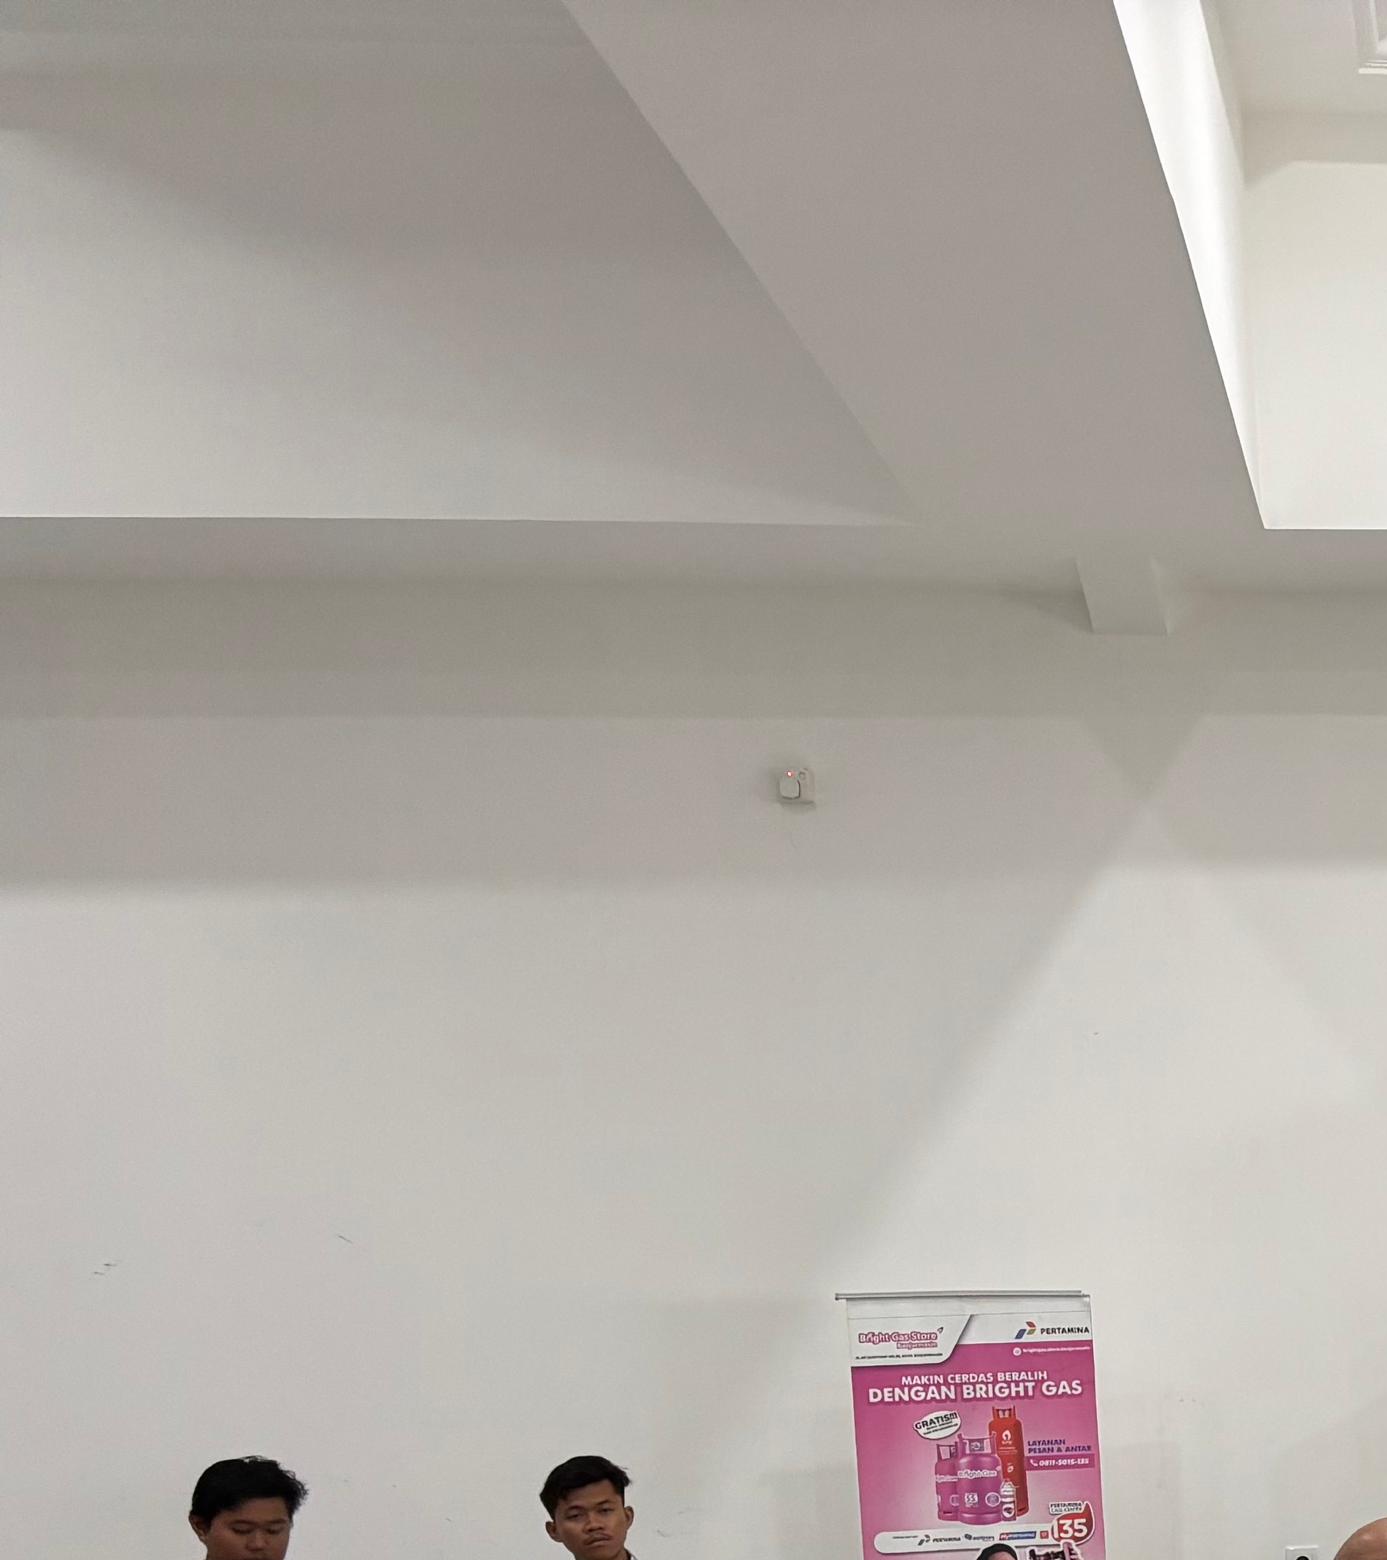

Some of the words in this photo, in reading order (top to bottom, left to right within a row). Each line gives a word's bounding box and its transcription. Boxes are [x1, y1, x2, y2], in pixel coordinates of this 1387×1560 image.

[891, 1332, 910, 1342] Gas
[911, 1331, 937, 1341] Store
[1040, 1326, 1090, 1335] PERTAMINA
[901, 1374, 944, 1386] MAKIN
[947, 1373, 994, 1384] CERDAS
[997, 1371, 1048, 1382] BERALIH
[868, 1384, 956, 1403] DENGAN
[962, 1382, 1035, 1399] BRIGHT
[1041, 1380, 1083, 1395] GAS
[1053, 1518, 1088, 1539] 135
